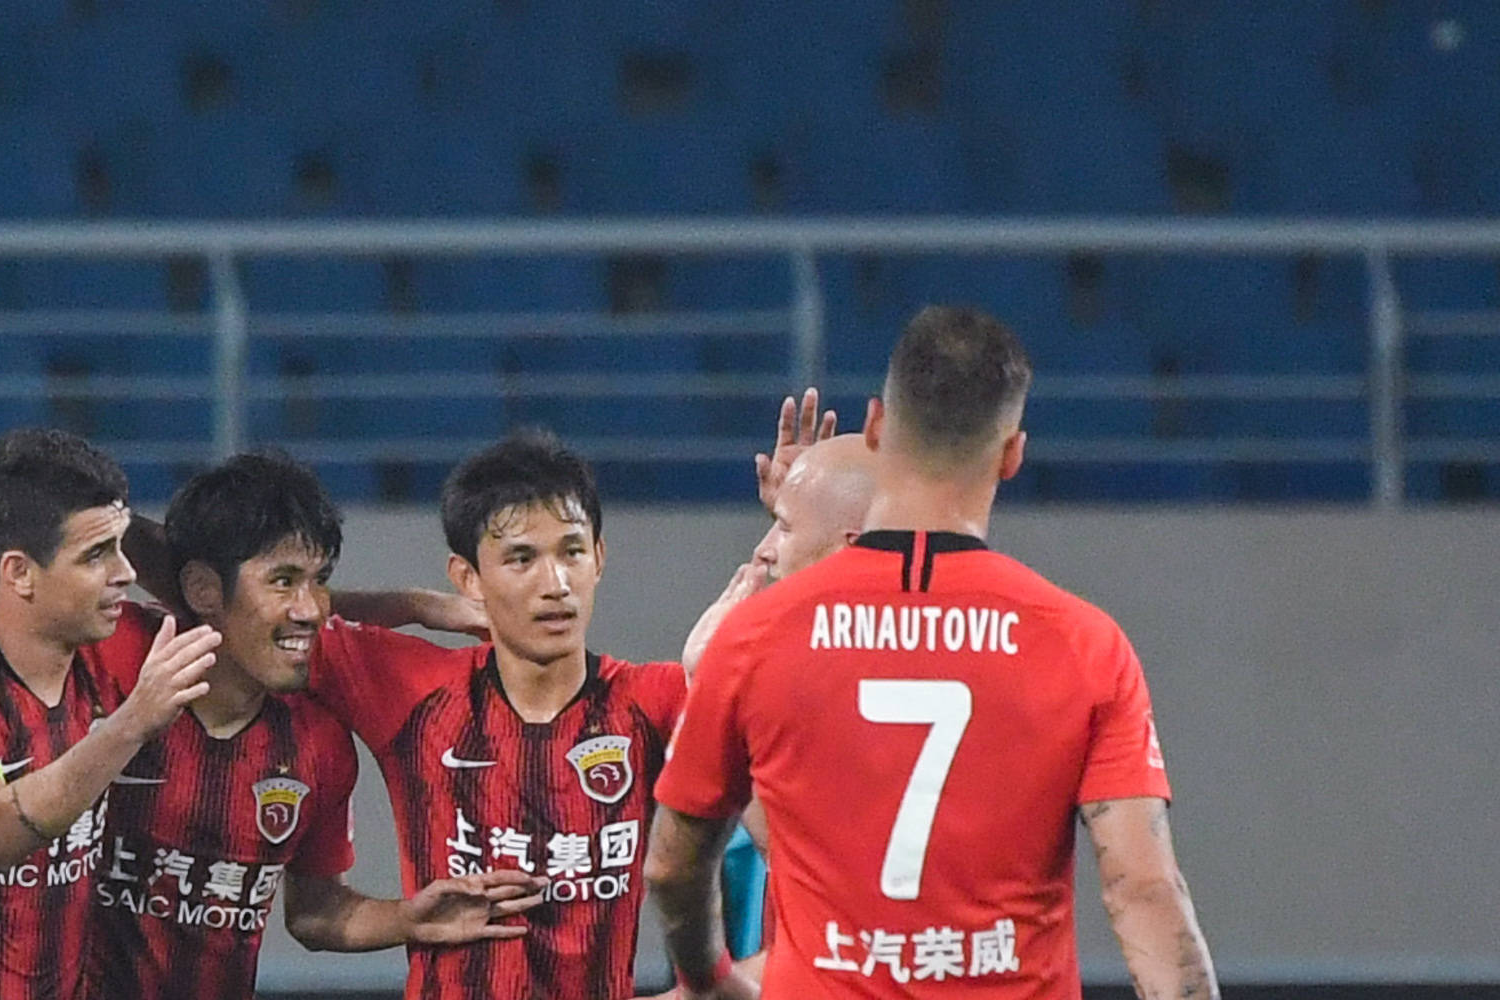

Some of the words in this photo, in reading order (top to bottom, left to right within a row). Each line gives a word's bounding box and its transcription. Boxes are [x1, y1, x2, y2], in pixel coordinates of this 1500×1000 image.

[809, 603, 1020, 655] ARNAUTOVIC
[857, 678, 973, 901] 7
[109, 836, 285, 905] 上汽集团
[445, 807, 639, 877] 上汽集团
[97, 881, 171, 918] SAIC
[177, 900, 268, 932] MOTOR
[813, 918, 1020, 984] 上汽荣威
